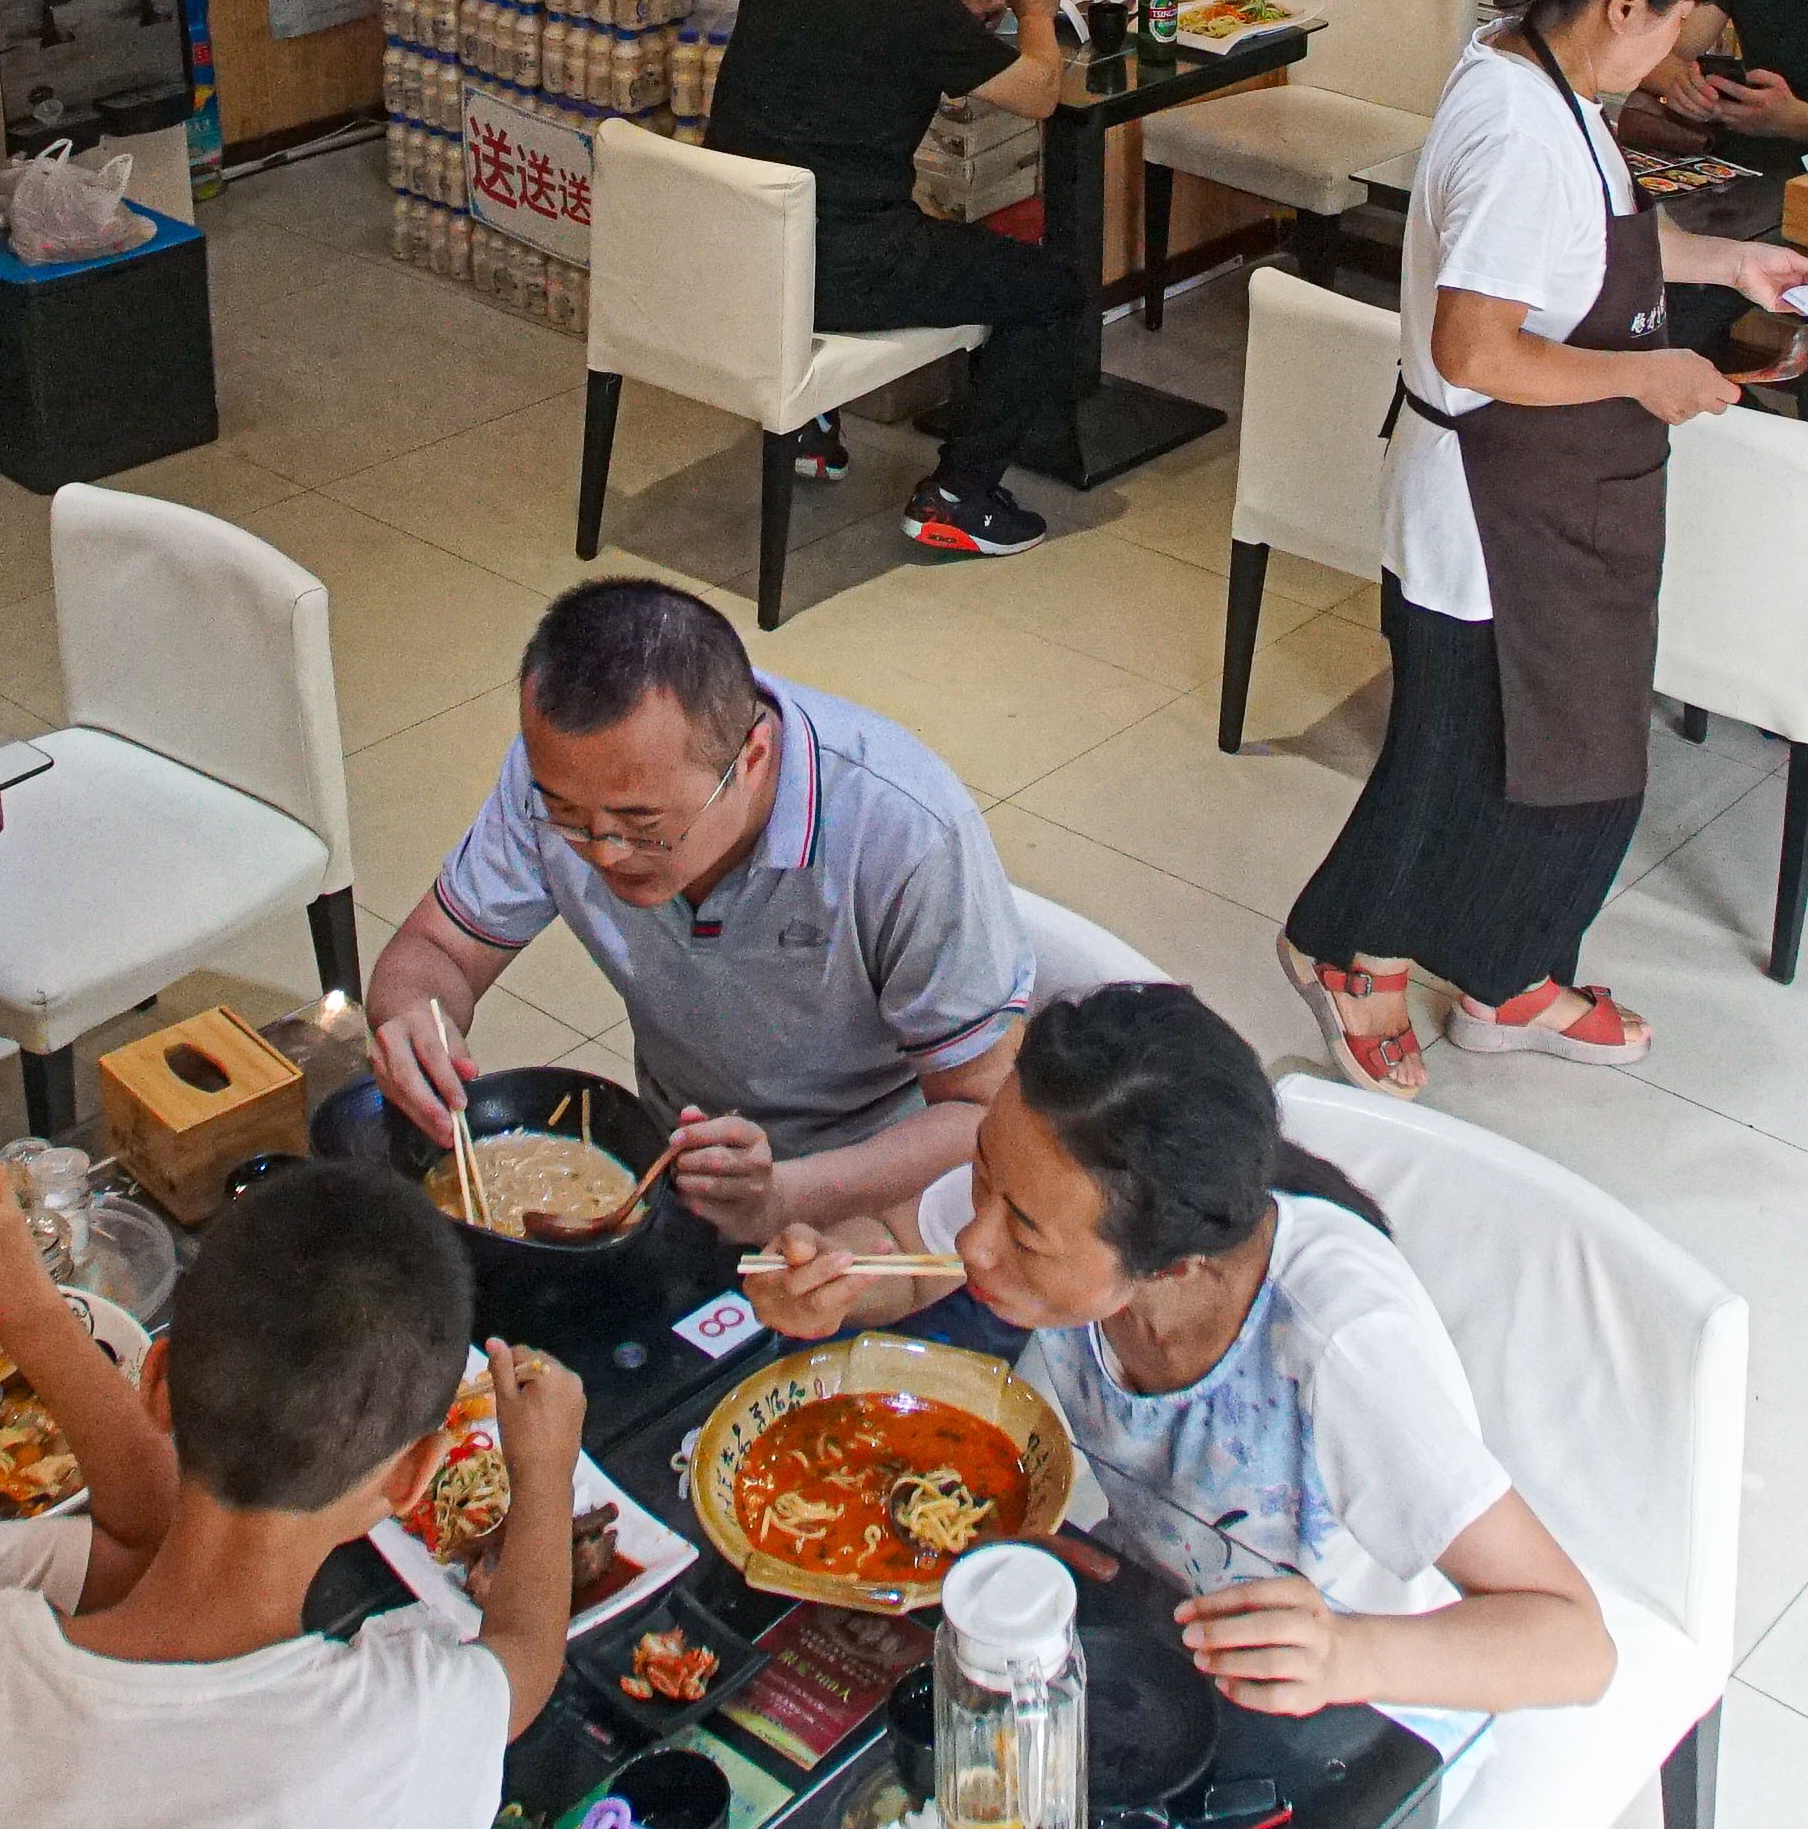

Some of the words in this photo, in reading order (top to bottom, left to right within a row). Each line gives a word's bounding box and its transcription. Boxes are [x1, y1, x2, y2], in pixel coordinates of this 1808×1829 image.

[469, 116, 591, 226] 送送送
[698, 1305, 746, 1338] 8
